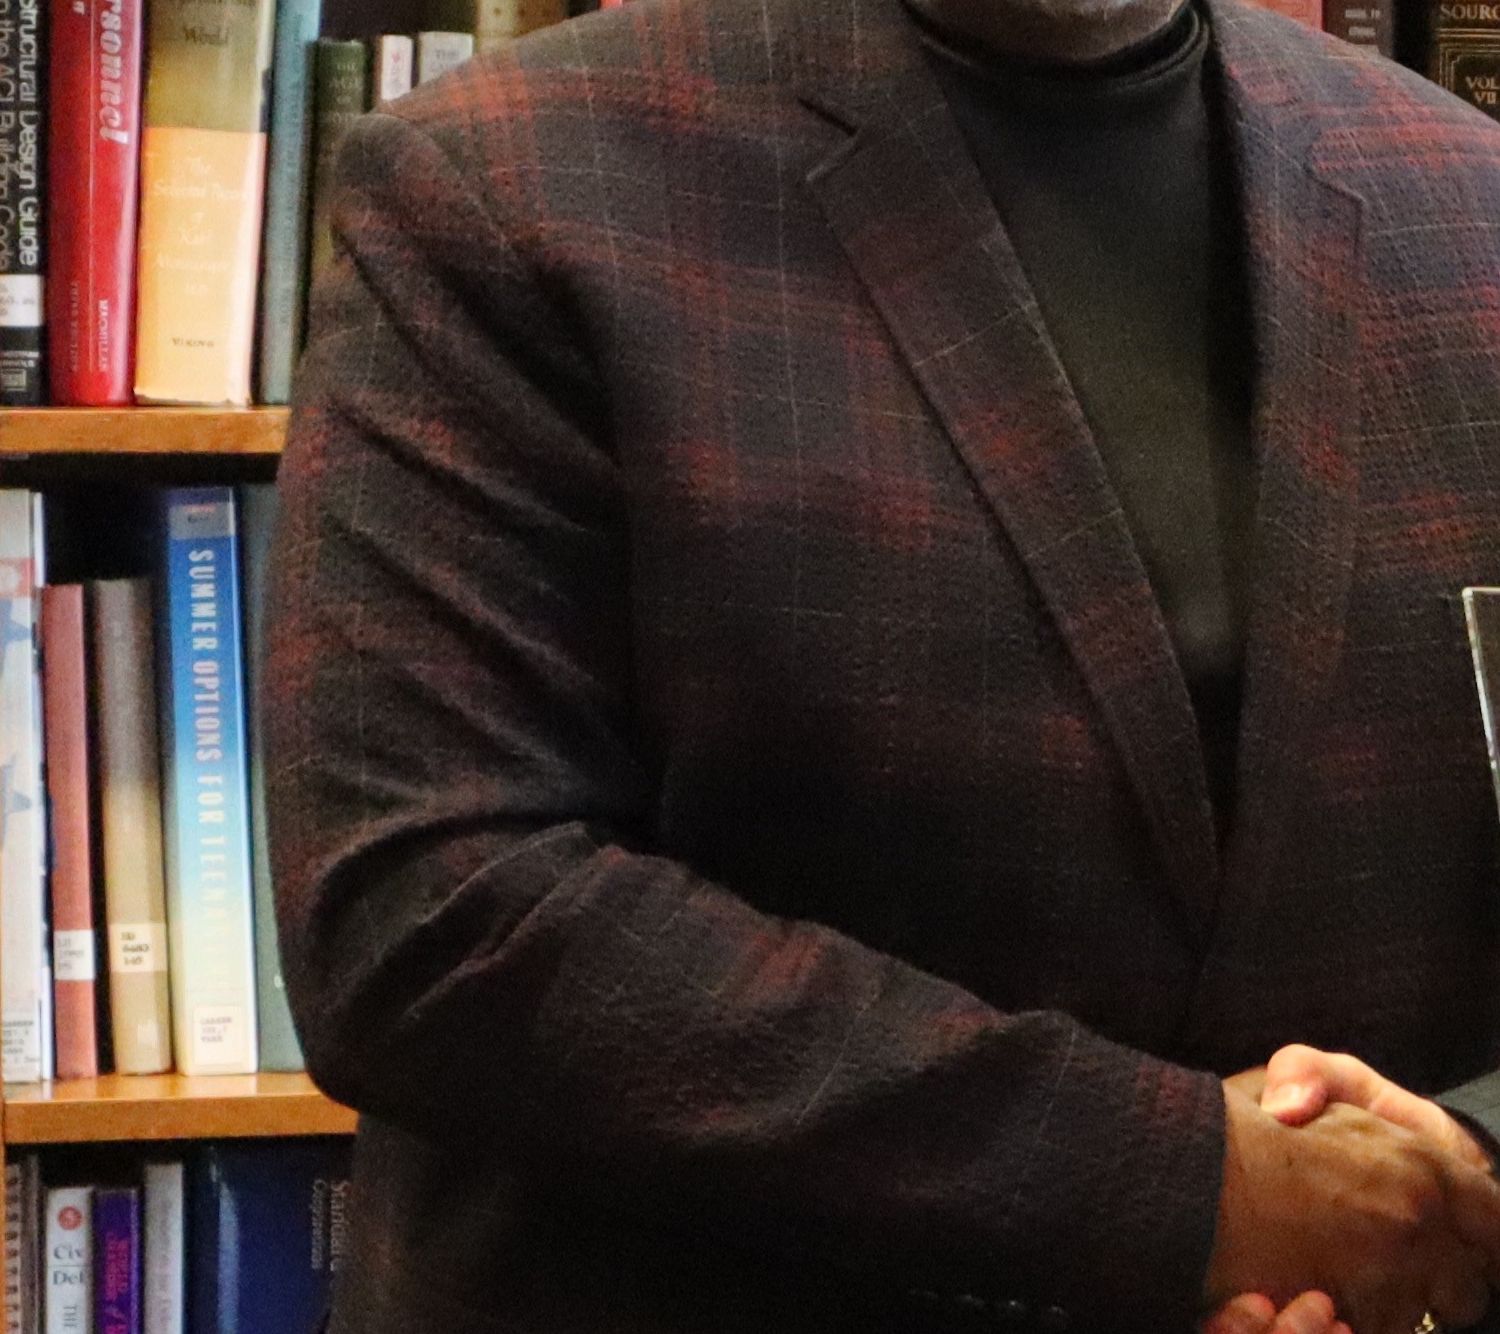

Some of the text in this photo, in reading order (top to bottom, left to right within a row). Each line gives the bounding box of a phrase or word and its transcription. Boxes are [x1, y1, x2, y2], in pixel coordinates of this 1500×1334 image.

[9, 110, 41, 189] Design
[16, 196, 41, 269] Guide
[171, 336, 216, 349] VIKING
[187, 549, 226, 824] SUMMER OPTIONS FOR
[62, 1303, 80, 1333] THE
